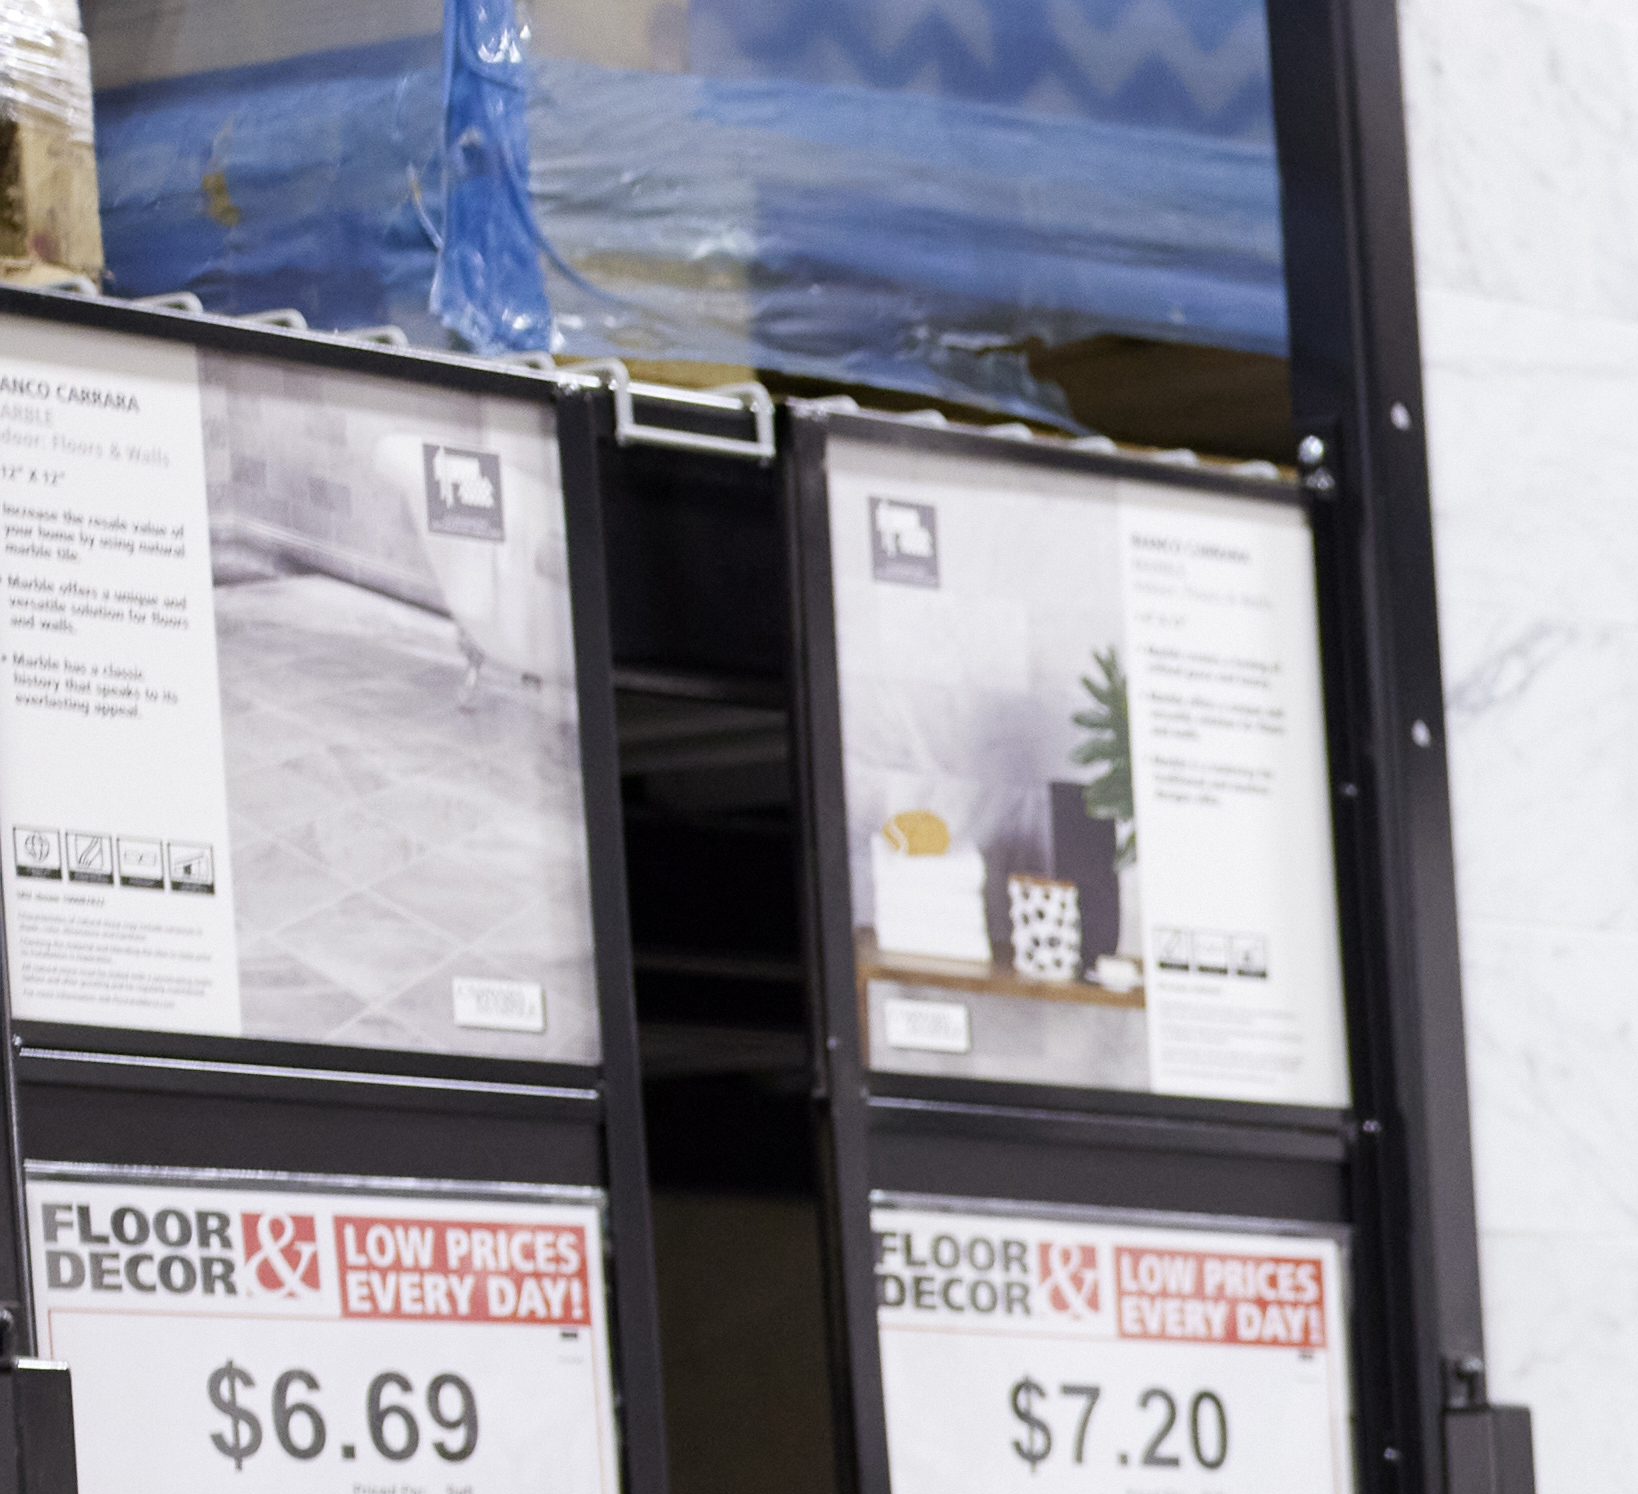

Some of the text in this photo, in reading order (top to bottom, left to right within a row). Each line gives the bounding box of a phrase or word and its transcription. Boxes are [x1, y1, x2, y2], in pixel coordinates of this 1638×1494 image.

[56, 384, 140, 413] CARRARA
[52, 432, 103, 457] Floors
[127, 444, 170, 468] Walls
[2, 500, 184, 539] Increase the resale value of
[5, 525, 185, 558] your home by using natural
[6, 543, 51, 558] marble
[8, 573, 54, 592] Marble
[60, 580, 98, 600] offers
[115, 589, 158, 607] unique
[163, 595, 187, 610] and
[10, 597, 189, 630] versatile solution for floors
[11, 613, 35, 628] and
[13, 650, 59, 670] Marble
[64, 655, 87, 674] has
[102, 662, 143, 681] classic
[14, 670, 178, 704] history that speaks to its
[15, 693, 90, 718] everlasting
[42, 1202, 321, 1299] FLOOR &
[343, 1223, 580, 1274] LOW PRICES
[46, 1250, 238, 1297] DECOR
[875, 1231, 1100, 1321] FLOOR &
[1120, 1253, 1321, 1301] LOW PRICES
[346, 1271, 585, 1320] EVERY DAY!
[878, 1274, 1032, 1316] DECOR
[1123, 1303, 1324, 1345] EVERY DAY!
[207, 1360, 480, 1472] $6.69
[1010, 1376, 1229, 1473] $7.20
